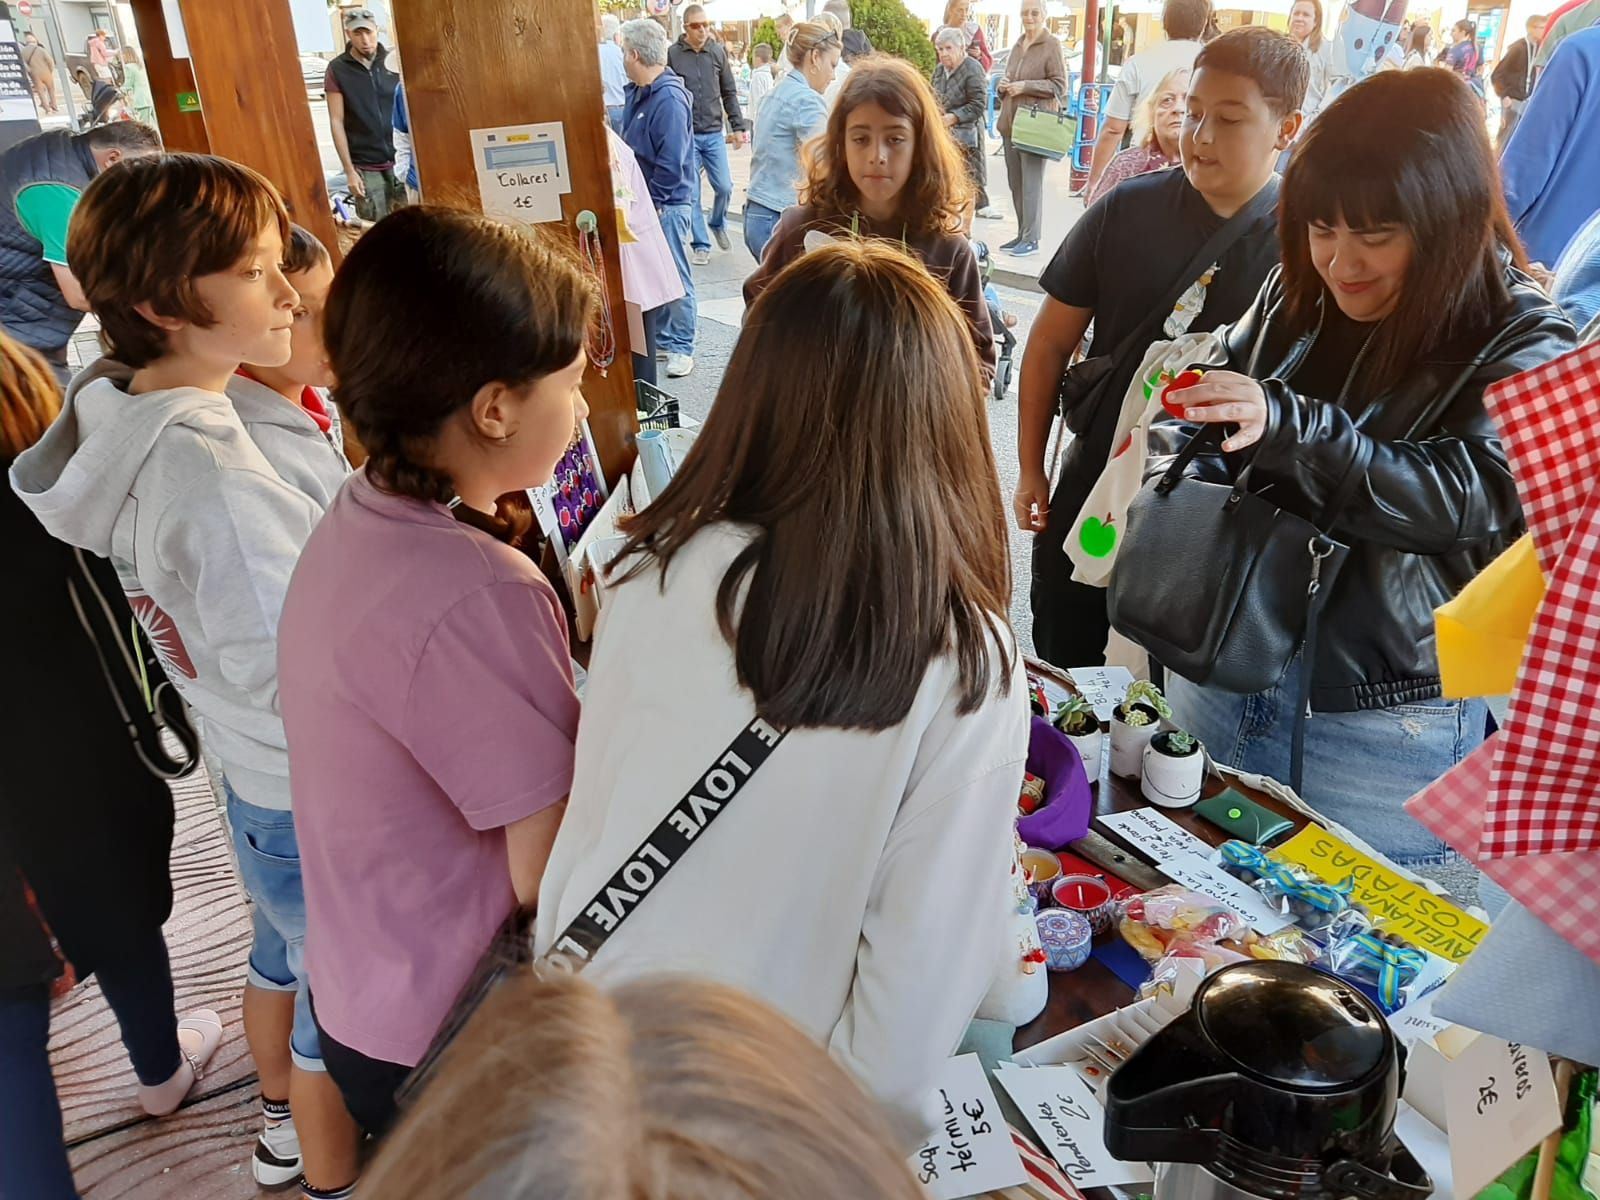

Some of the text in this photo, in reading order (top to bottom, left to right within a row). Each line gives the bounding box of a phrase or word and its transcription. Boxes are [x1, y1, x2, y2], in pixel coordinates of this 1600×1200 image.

[497, 172, 548, 187] Collares
[513, 196, 533, 208] 1€
[668, 750, 753, 840] LOVE
[586, 842, 671, 931] LOVE
[1311, 839, 1483, 945] TOSTADAS
[540, 935, 589, 977] LO
[963, 1098, 991, 1135] 5€
[1477, 1076, 1498, 1115] 2€
[939, 1089, 976, 1172] térmi
[1038, 1102, 1096, 1180] Pendientes
[918, 1142, 940, 1184] Saq
